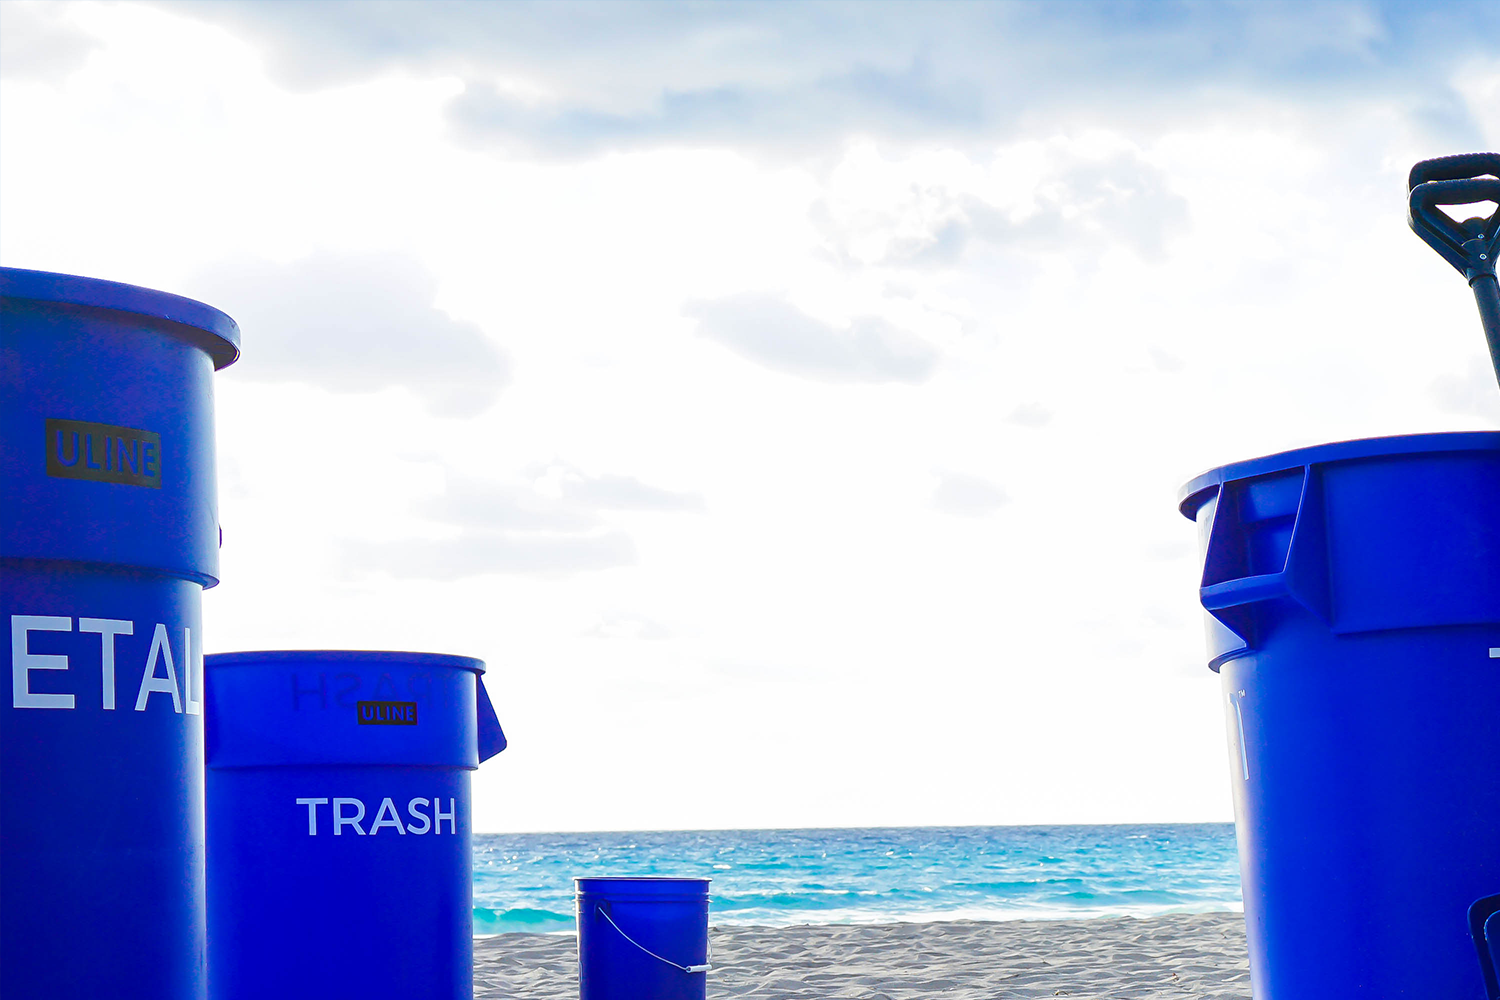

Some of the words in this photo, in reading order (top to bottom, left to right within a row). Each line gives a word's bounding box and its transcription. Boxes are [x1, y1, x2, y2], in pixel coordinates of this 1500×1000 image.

[55, 428, 156, 478] ULINE
[362, 705, 414, 721] ULINE
[296, 797, 456, 836] TRASH
